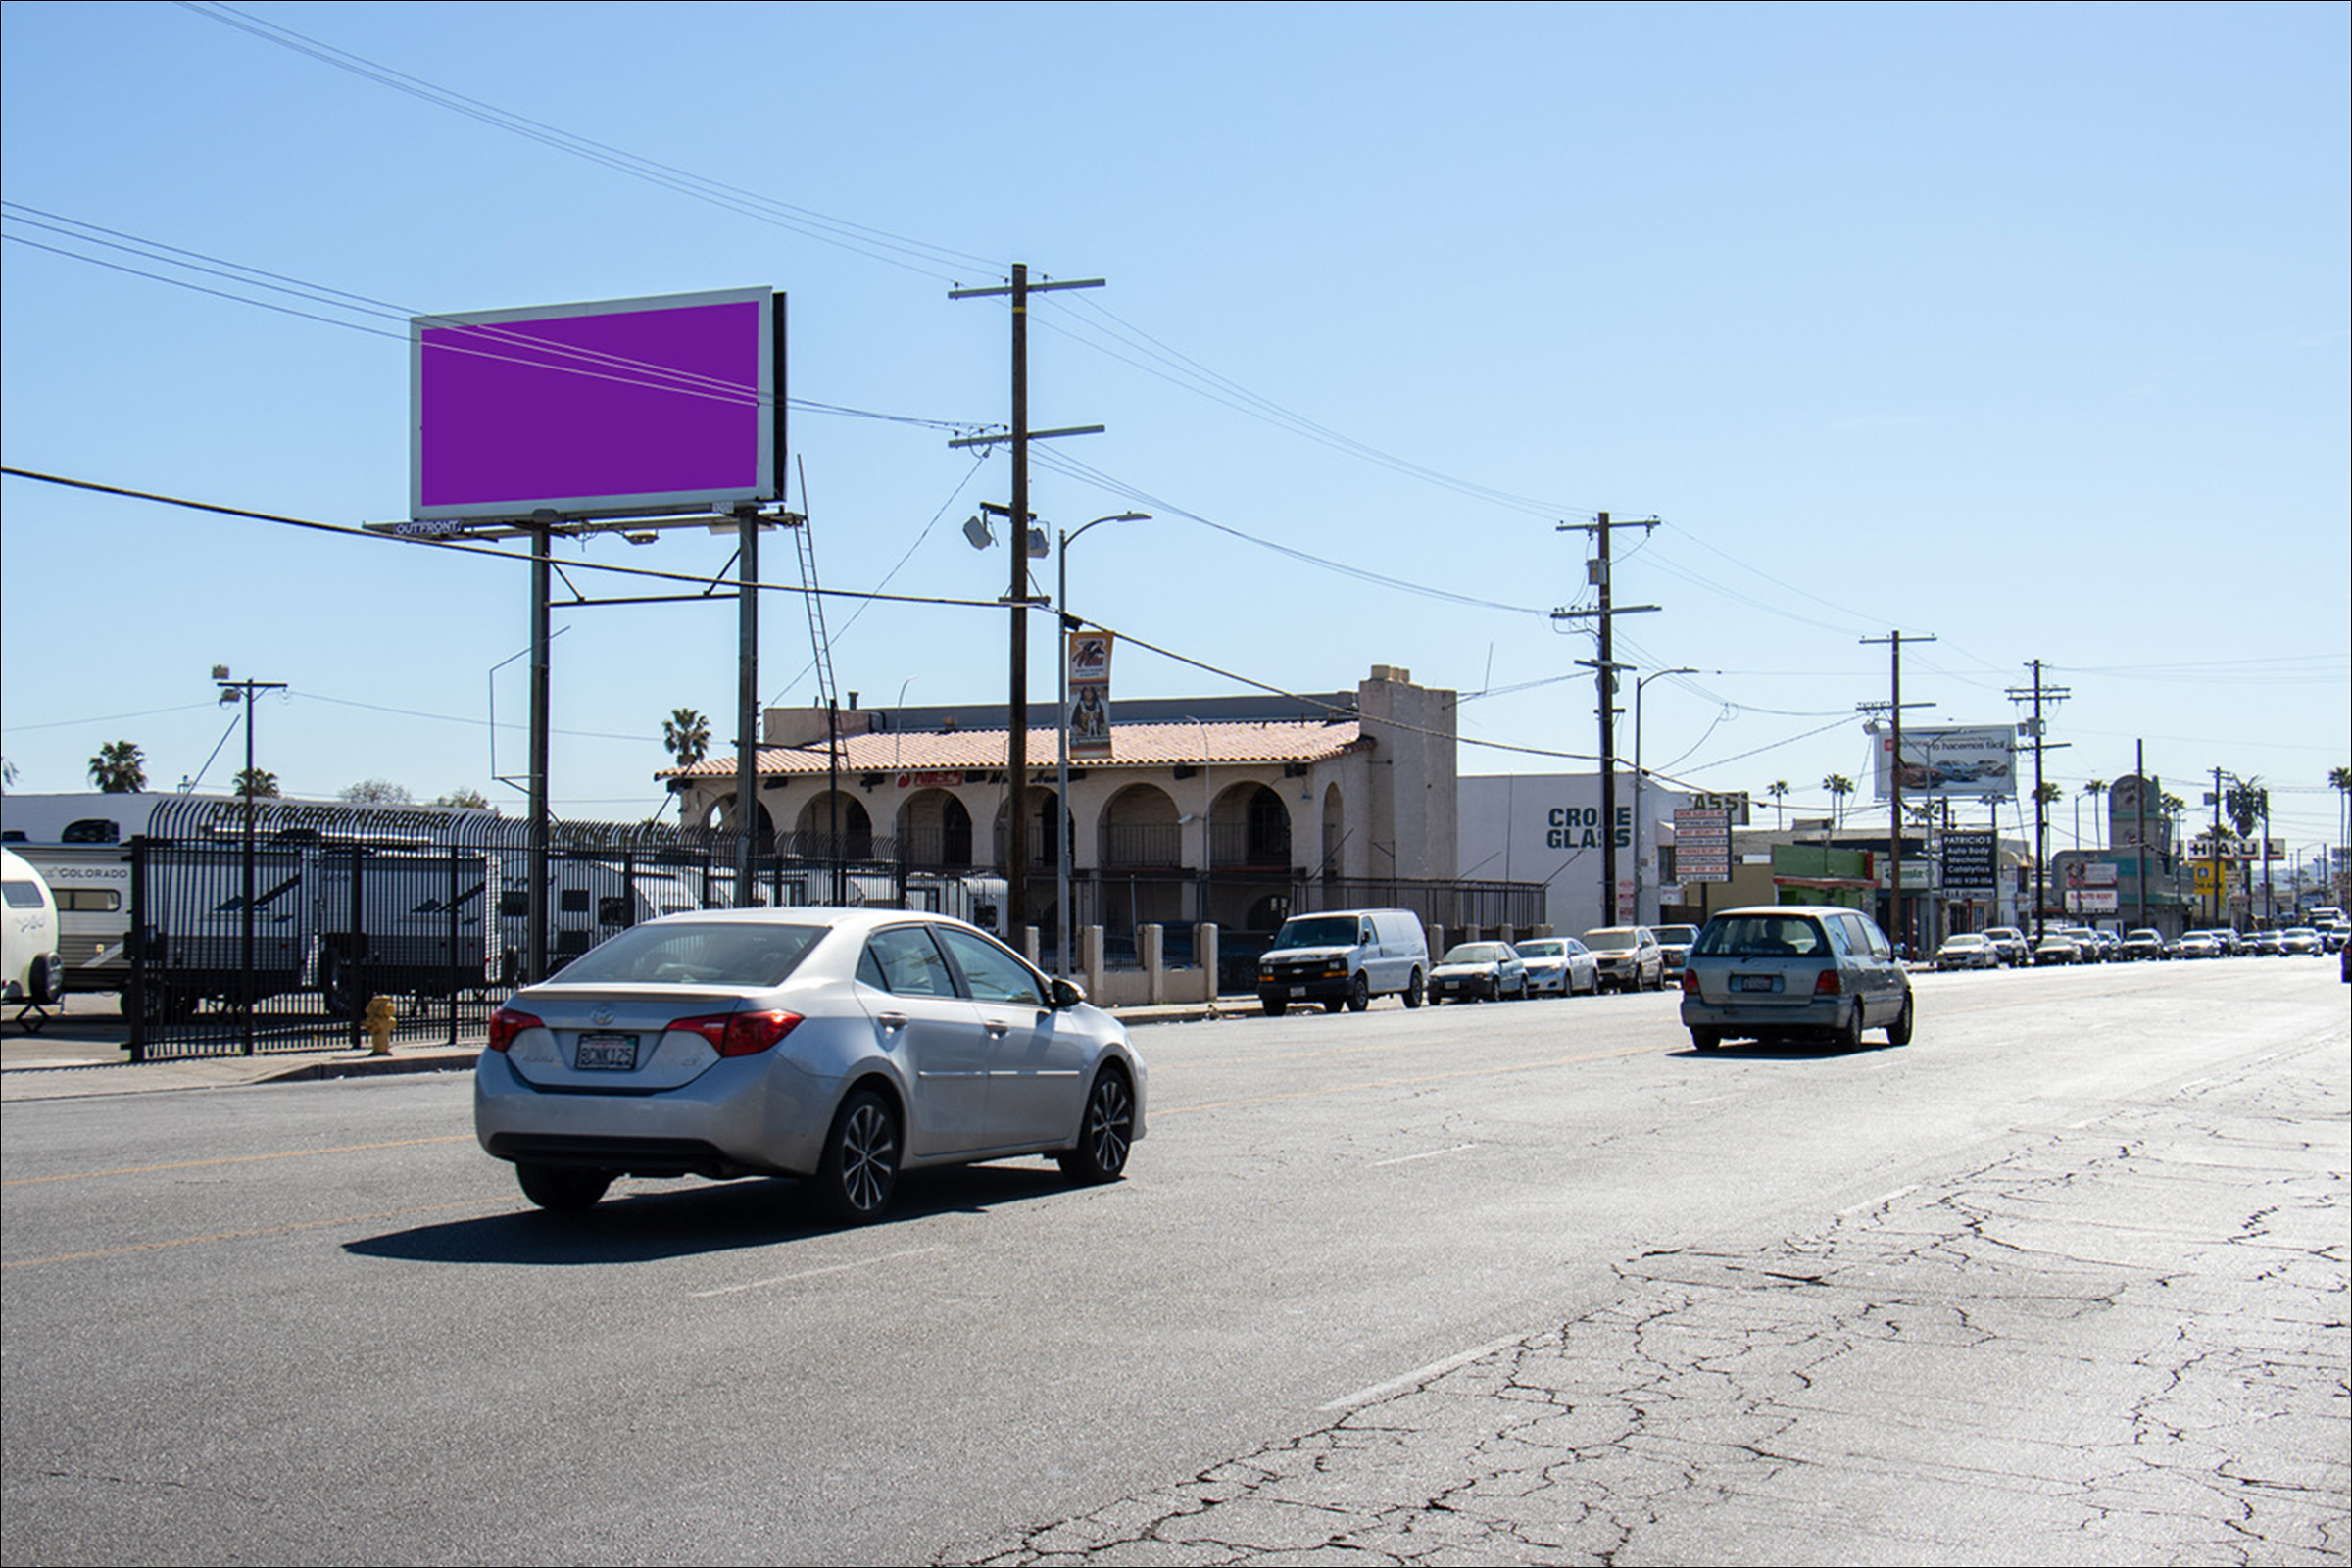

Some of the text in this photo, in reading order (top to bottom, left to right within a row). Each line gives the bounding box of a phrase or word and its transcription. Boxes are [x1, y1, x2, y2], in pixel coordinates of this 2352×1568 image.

[1548, 807, 1631, 827] CROE
[1947, 856, 1989, 864] Mechanic
[59, 867, 128, 879] COLORADO
